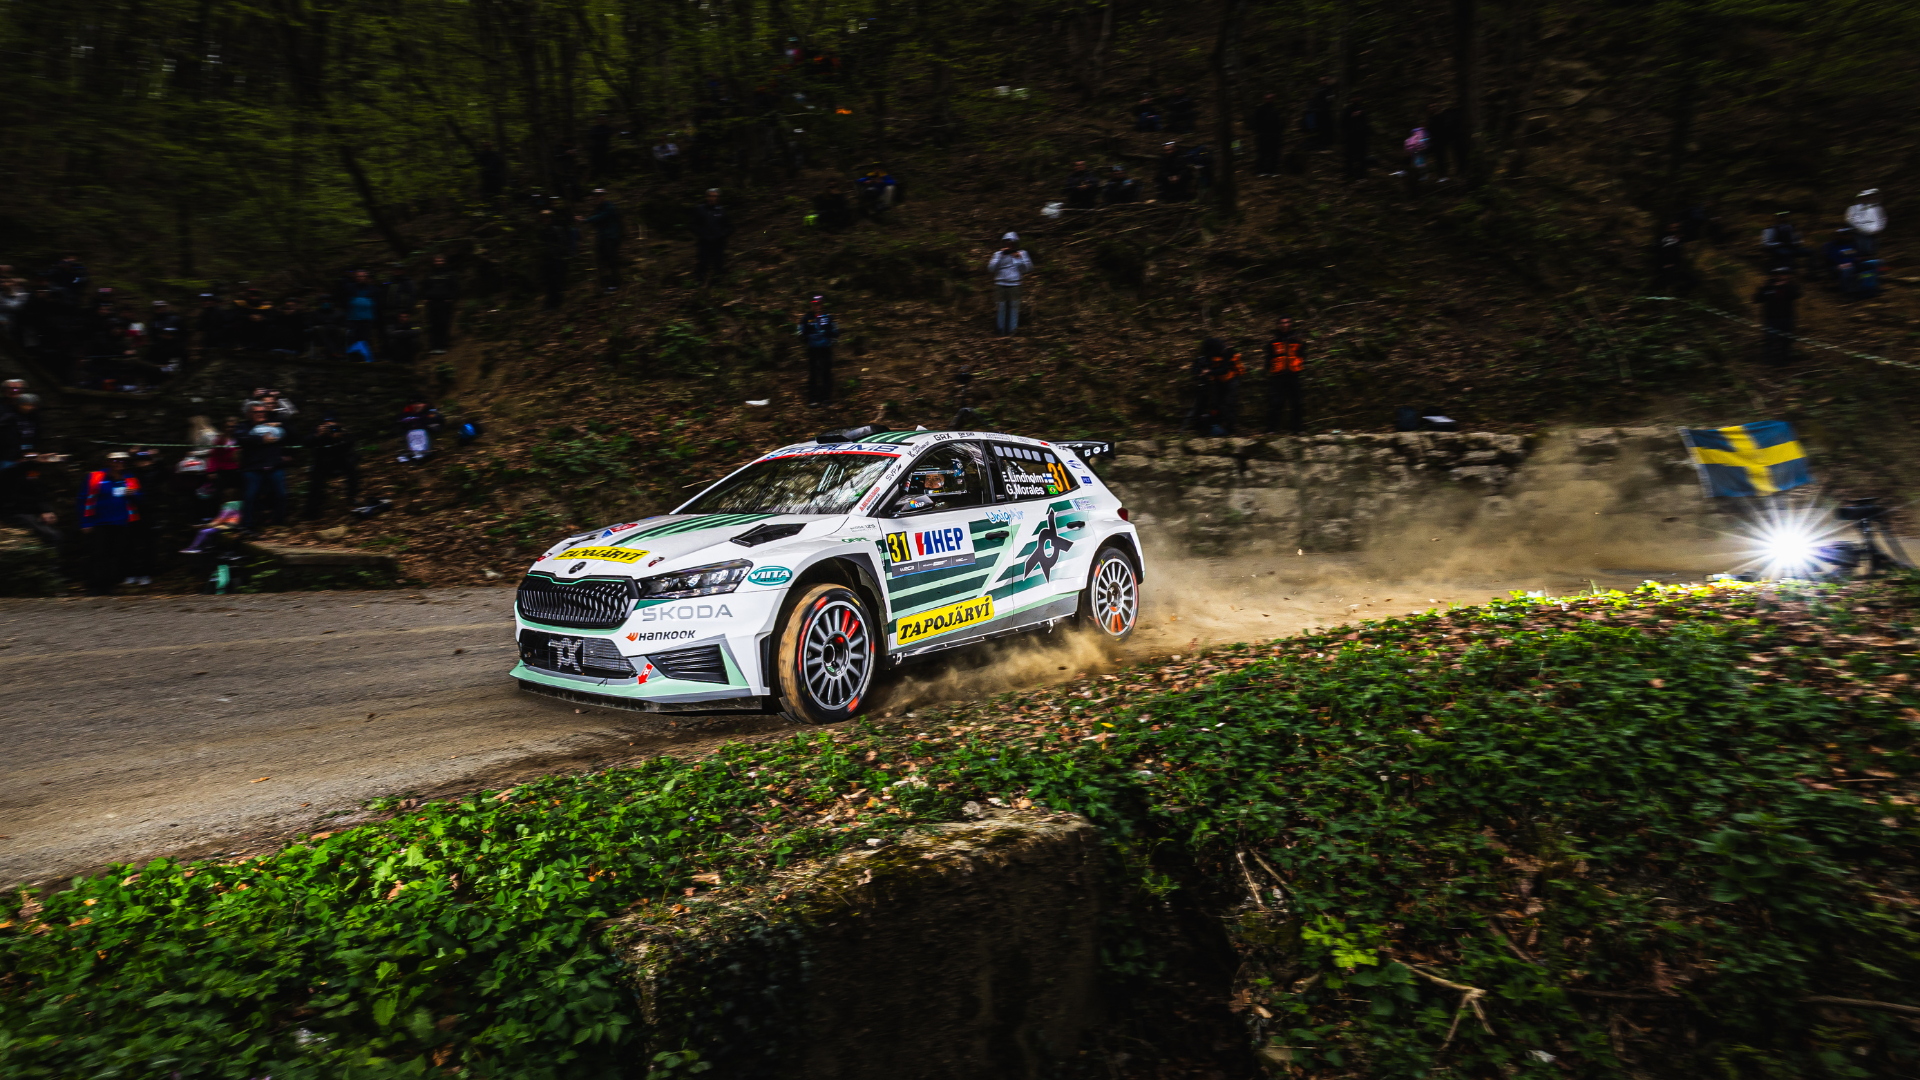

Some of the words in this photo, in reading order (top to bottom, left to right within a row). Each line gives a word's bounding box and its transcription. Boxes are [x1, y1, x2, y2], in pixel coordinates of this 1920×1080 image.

[1002, 472, 1044, 483] E.Lindholm
[1047, 462, 1071, 492] 31
[1005, 484, 1045, 496] G.Morales
[887, 532, 911, 563] 31
[932, 527, 964, 553] HEP
[750, 569, 791, 580] VIITA
